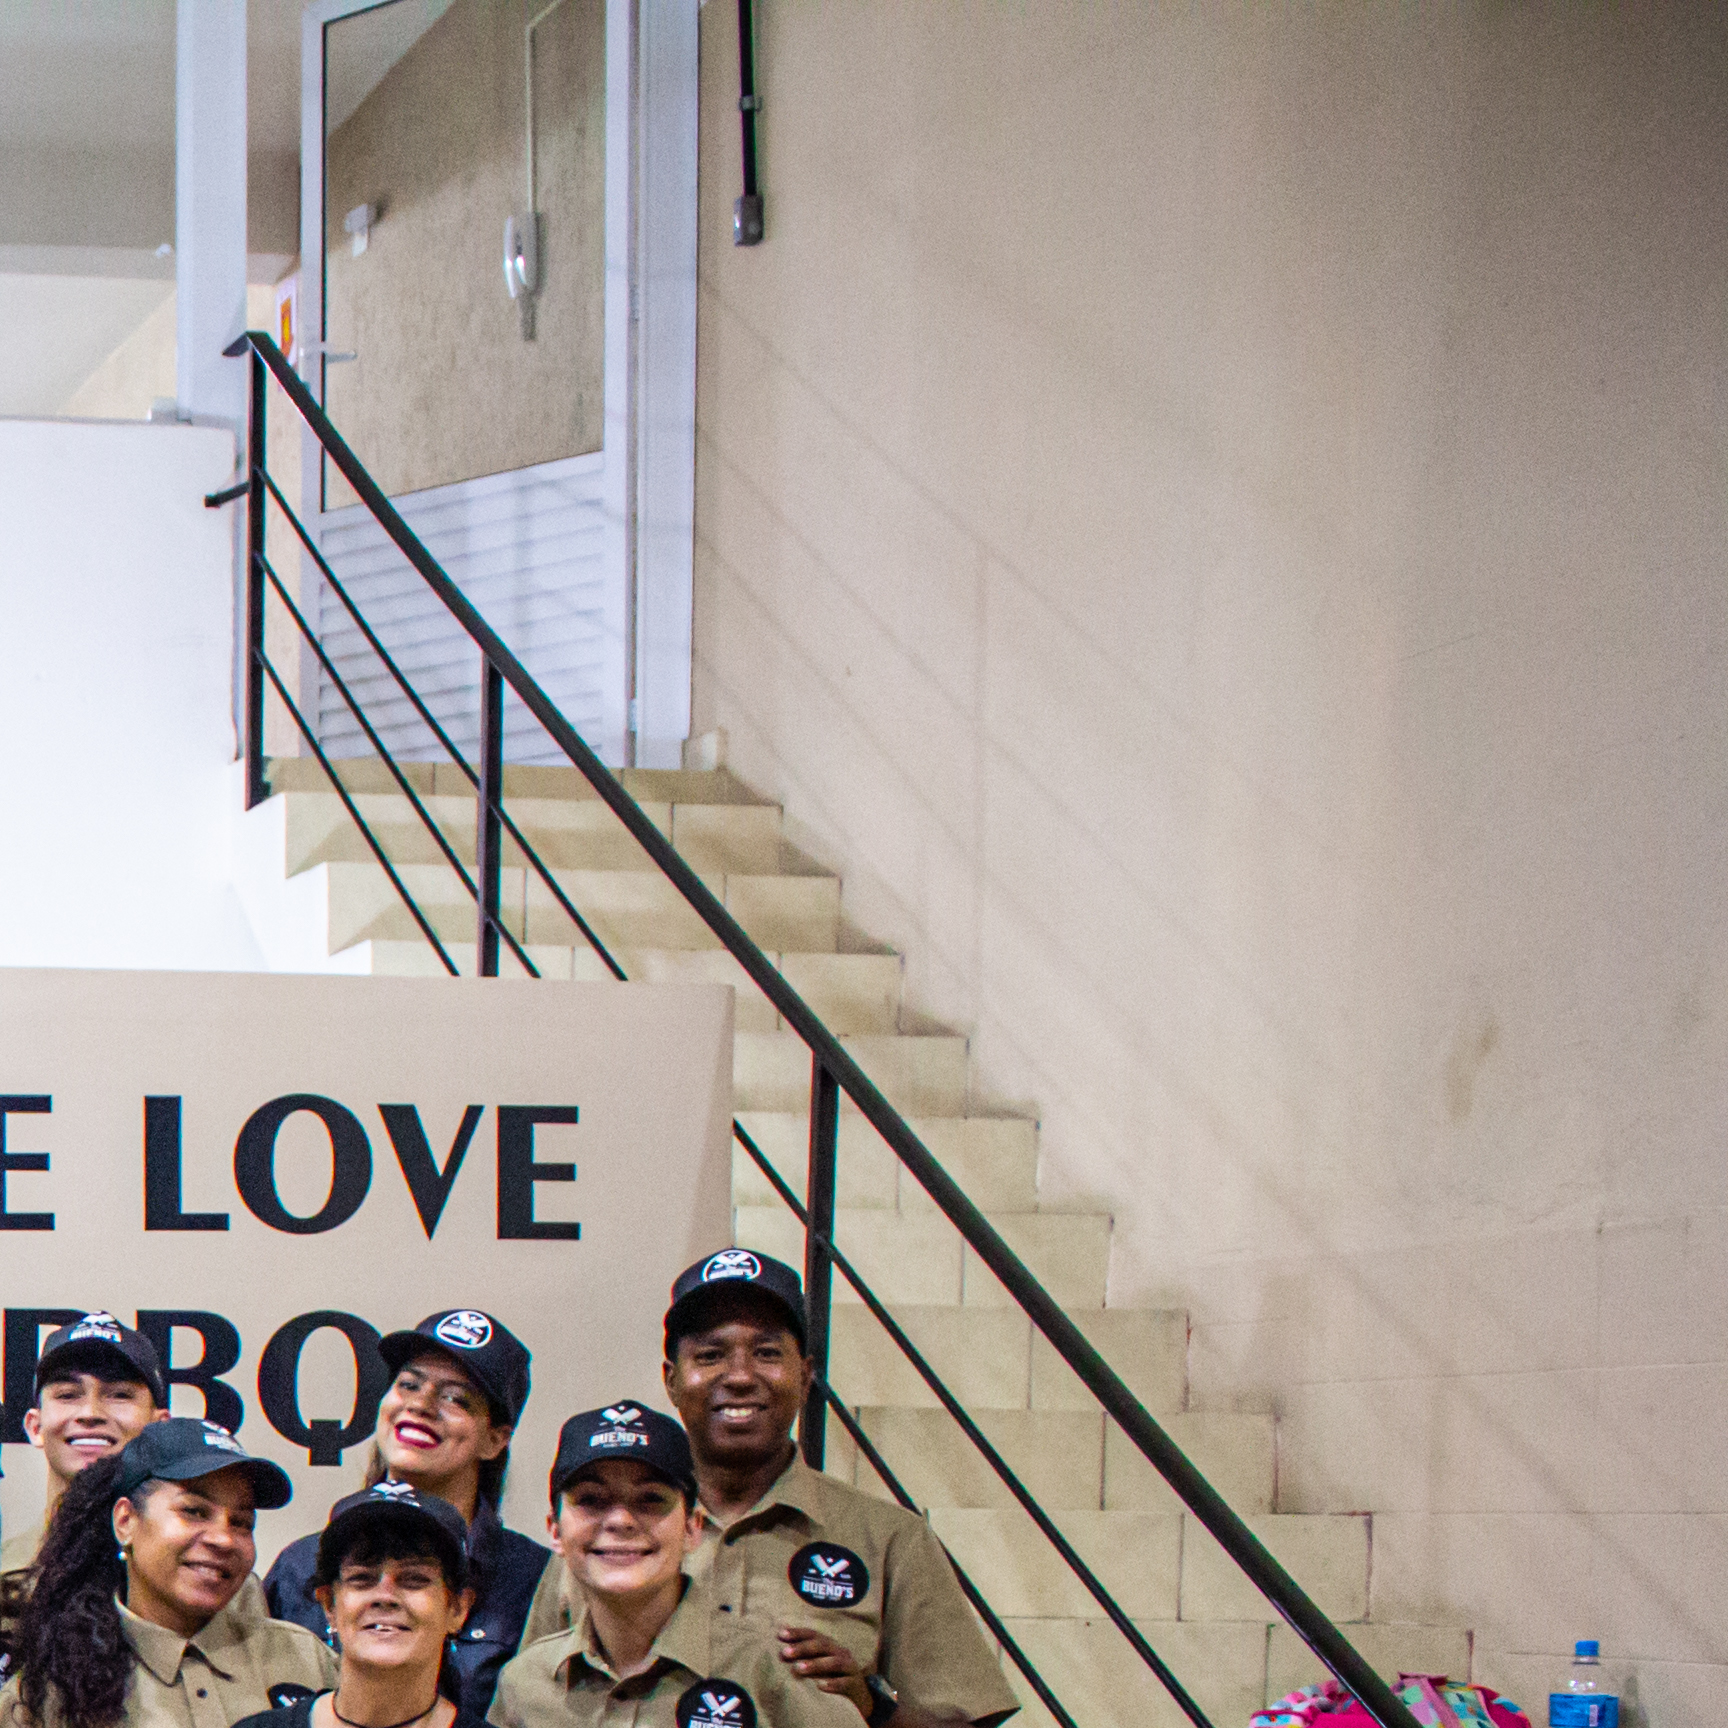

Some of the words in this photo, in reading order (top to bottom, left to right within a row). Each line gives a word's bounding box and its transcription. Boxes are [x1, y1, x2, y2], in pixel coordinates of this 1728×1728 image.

[144, 1092, 581, 1241] LOVE
[589, 1431, 650, 1447] BUENO'S
[801, 1579, 854, 1599] BUENO'S
